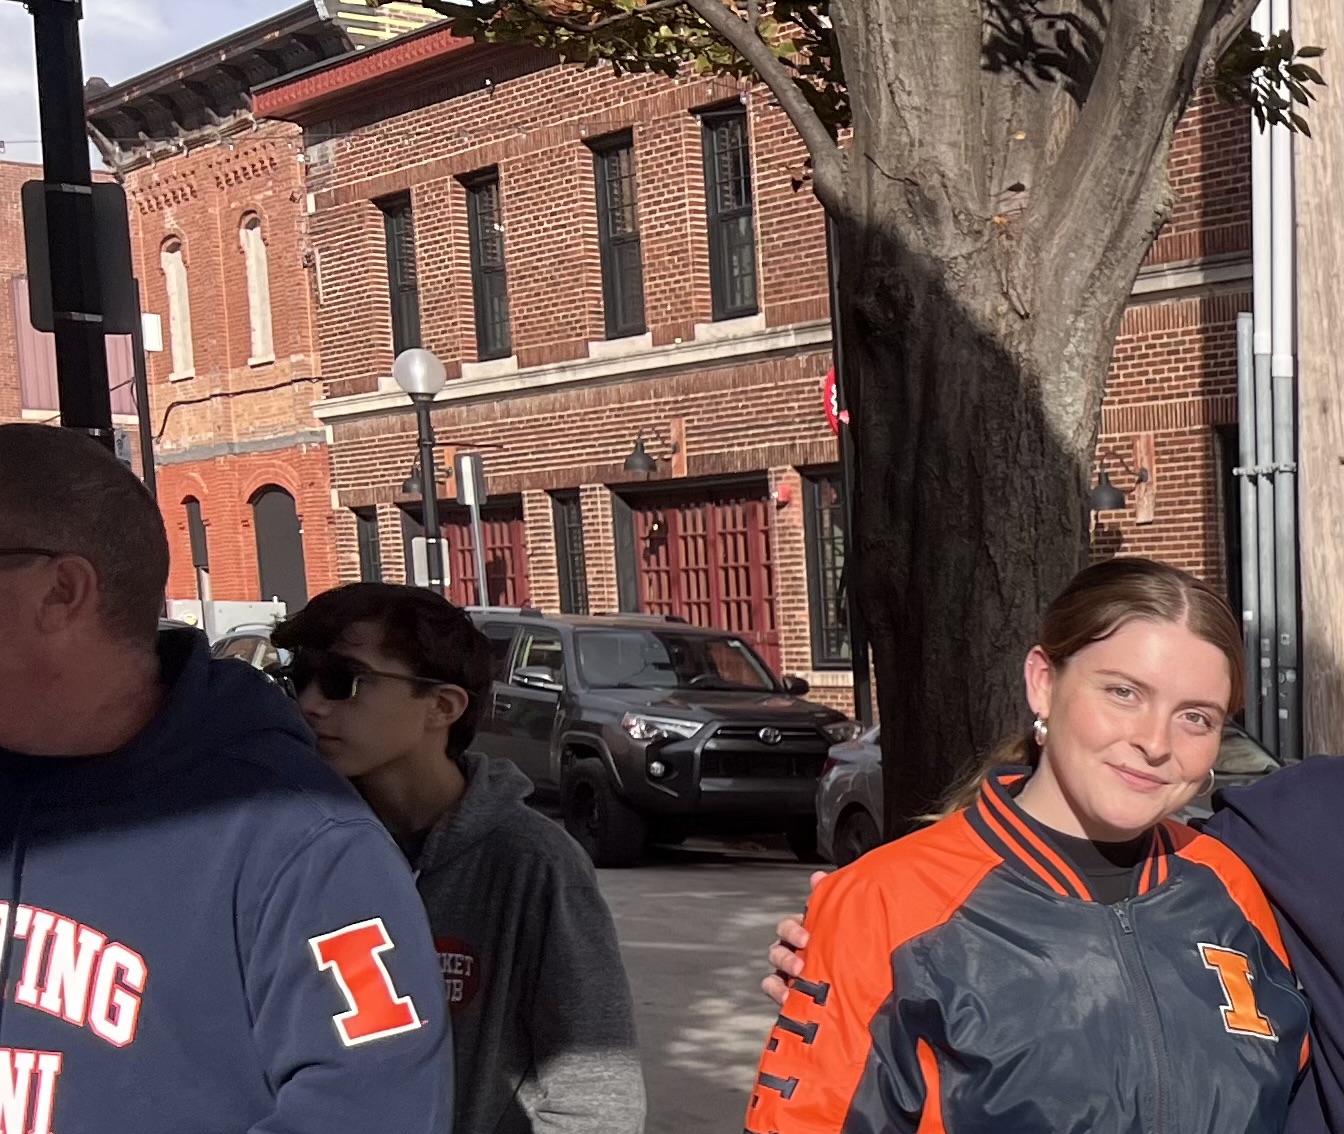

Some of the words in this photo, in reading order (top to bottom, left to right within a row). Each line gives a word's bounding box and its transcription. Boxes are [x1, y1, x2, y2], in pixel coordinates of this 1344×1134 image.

[308, 916, 421, 1047] I
[437, 952, 475, 977] KET
[1197, 942, 1279, 1042] I
